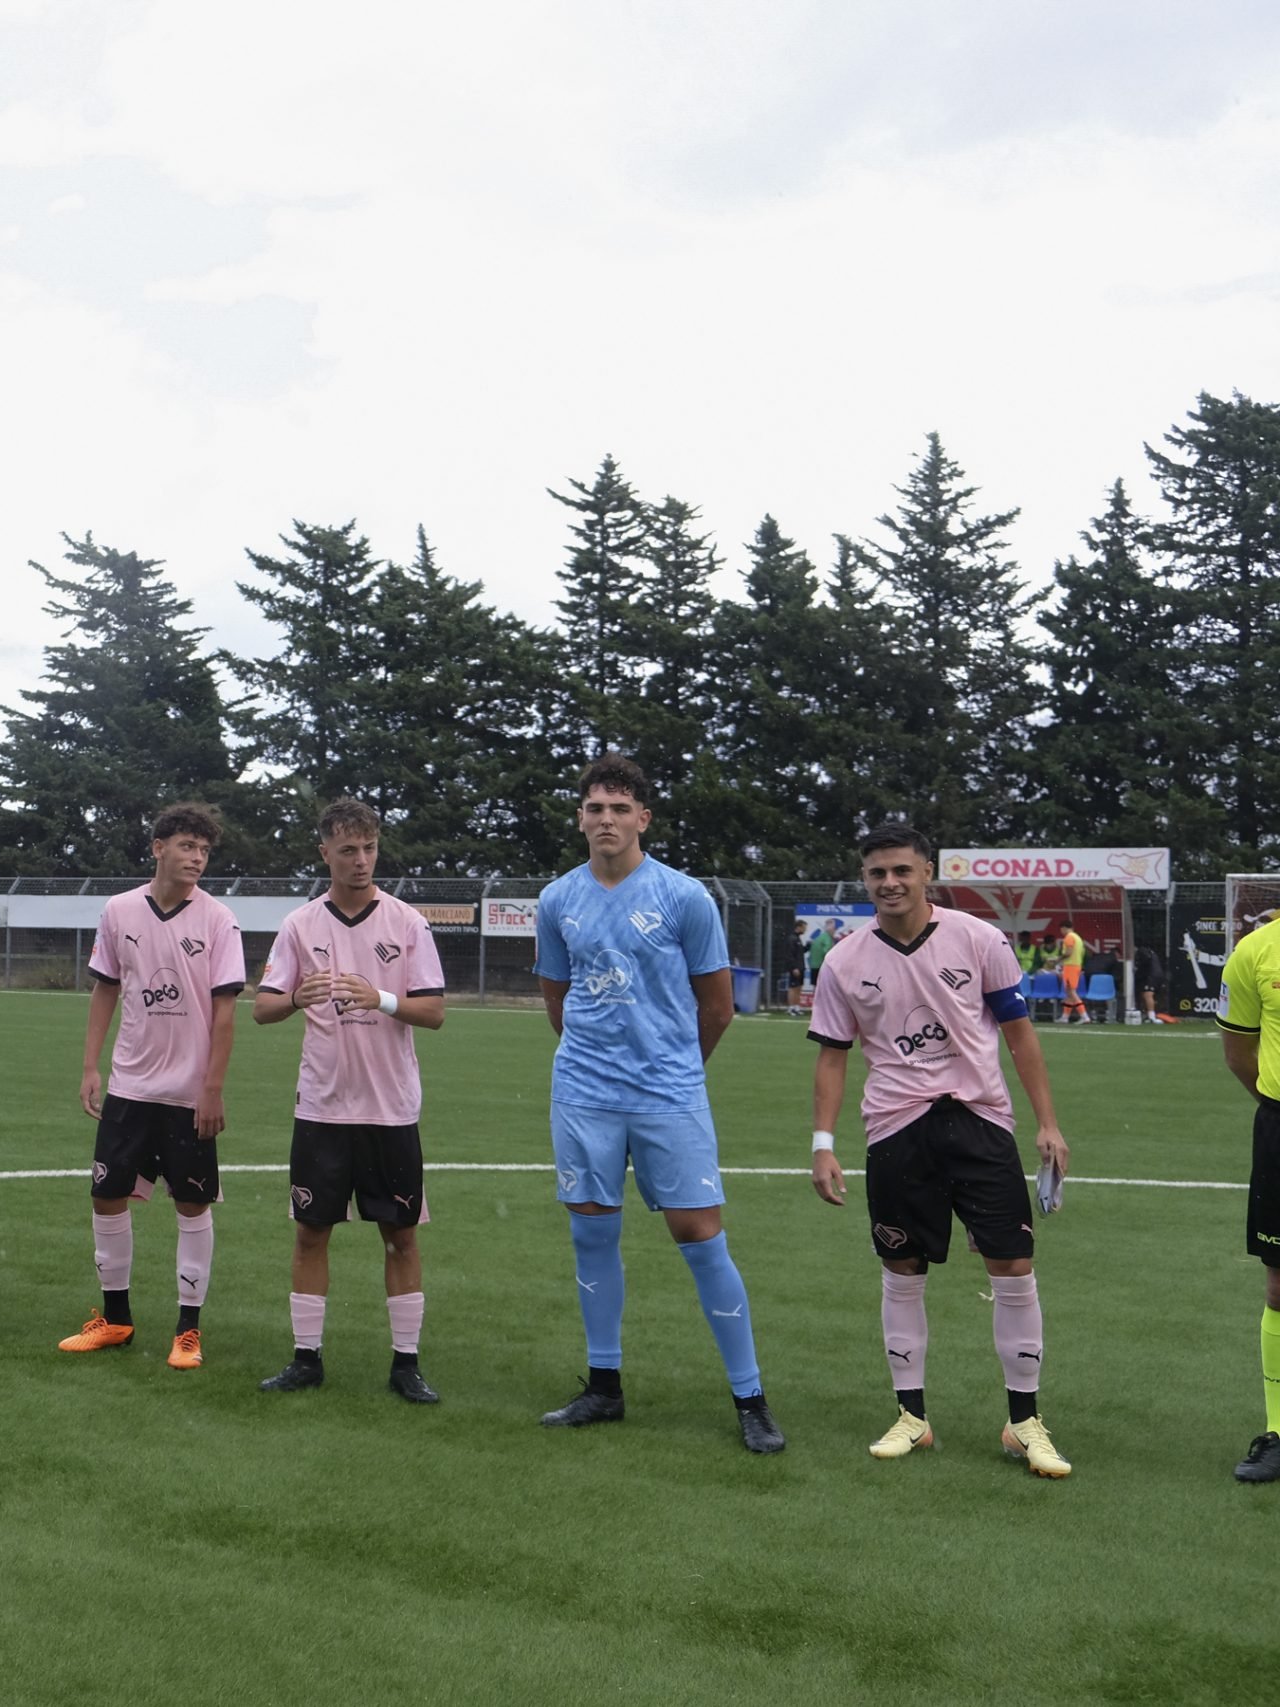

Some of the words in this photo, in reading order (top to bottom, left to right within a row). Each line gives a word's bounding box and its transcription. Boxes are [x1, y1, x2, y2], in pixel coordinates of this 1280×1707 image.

[972, 859, 1074, 878] CONAD
[1076, 870, 1100, 878] CITY
[488, 903, 526, 925] STOCK
[1194, 920, 1217, 930] SINCE
[141, 983, 180, 1008] Decò
[894, 1022, 948, 1057] Decò
